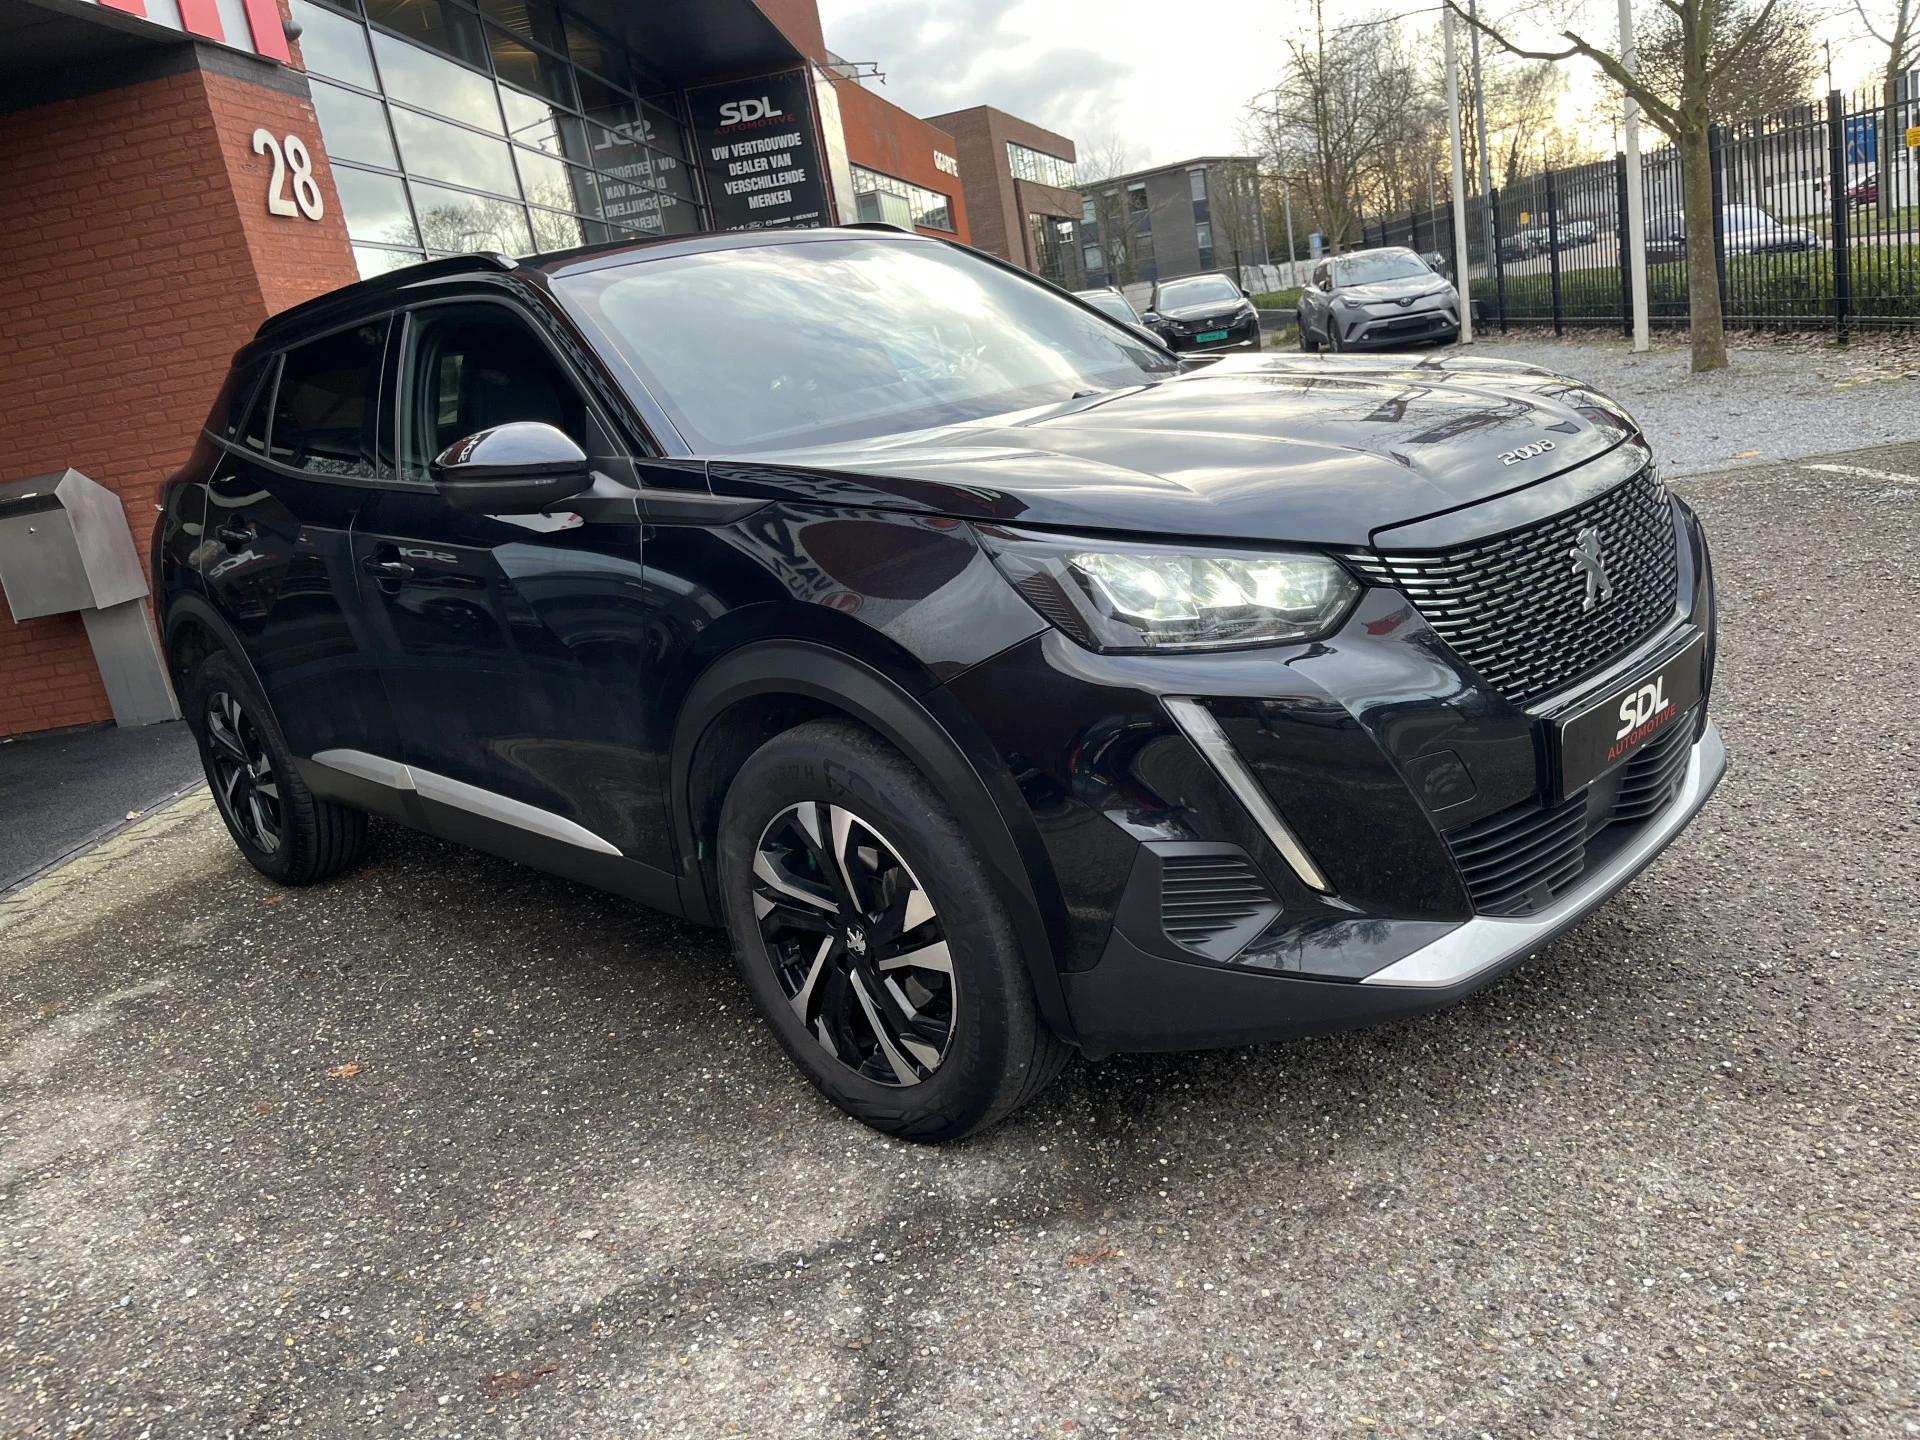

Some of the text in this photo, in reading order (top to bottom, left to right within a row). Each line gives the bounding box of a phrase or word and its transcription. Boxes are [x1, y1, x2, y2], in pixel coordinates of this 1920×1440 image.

[713, 113, 795, 136] AUTOMOTIVE
[719, 96, 783, 126] SDL
[711, 132, 802, 161] UW VERTROUWDE
[252, 128, 325, 222] 28
[728, 152, 793, 177] DEALER VAN
[724, 168, 807, 196] VERSCHILLENDE
[748, 189, 792, 210] MERKEN
[1497, 439, 1556, 466] 2008
[1615, 675, 1669, 741] SDL
[1607, 703, 1677, 762] AUTOMOTIVE
